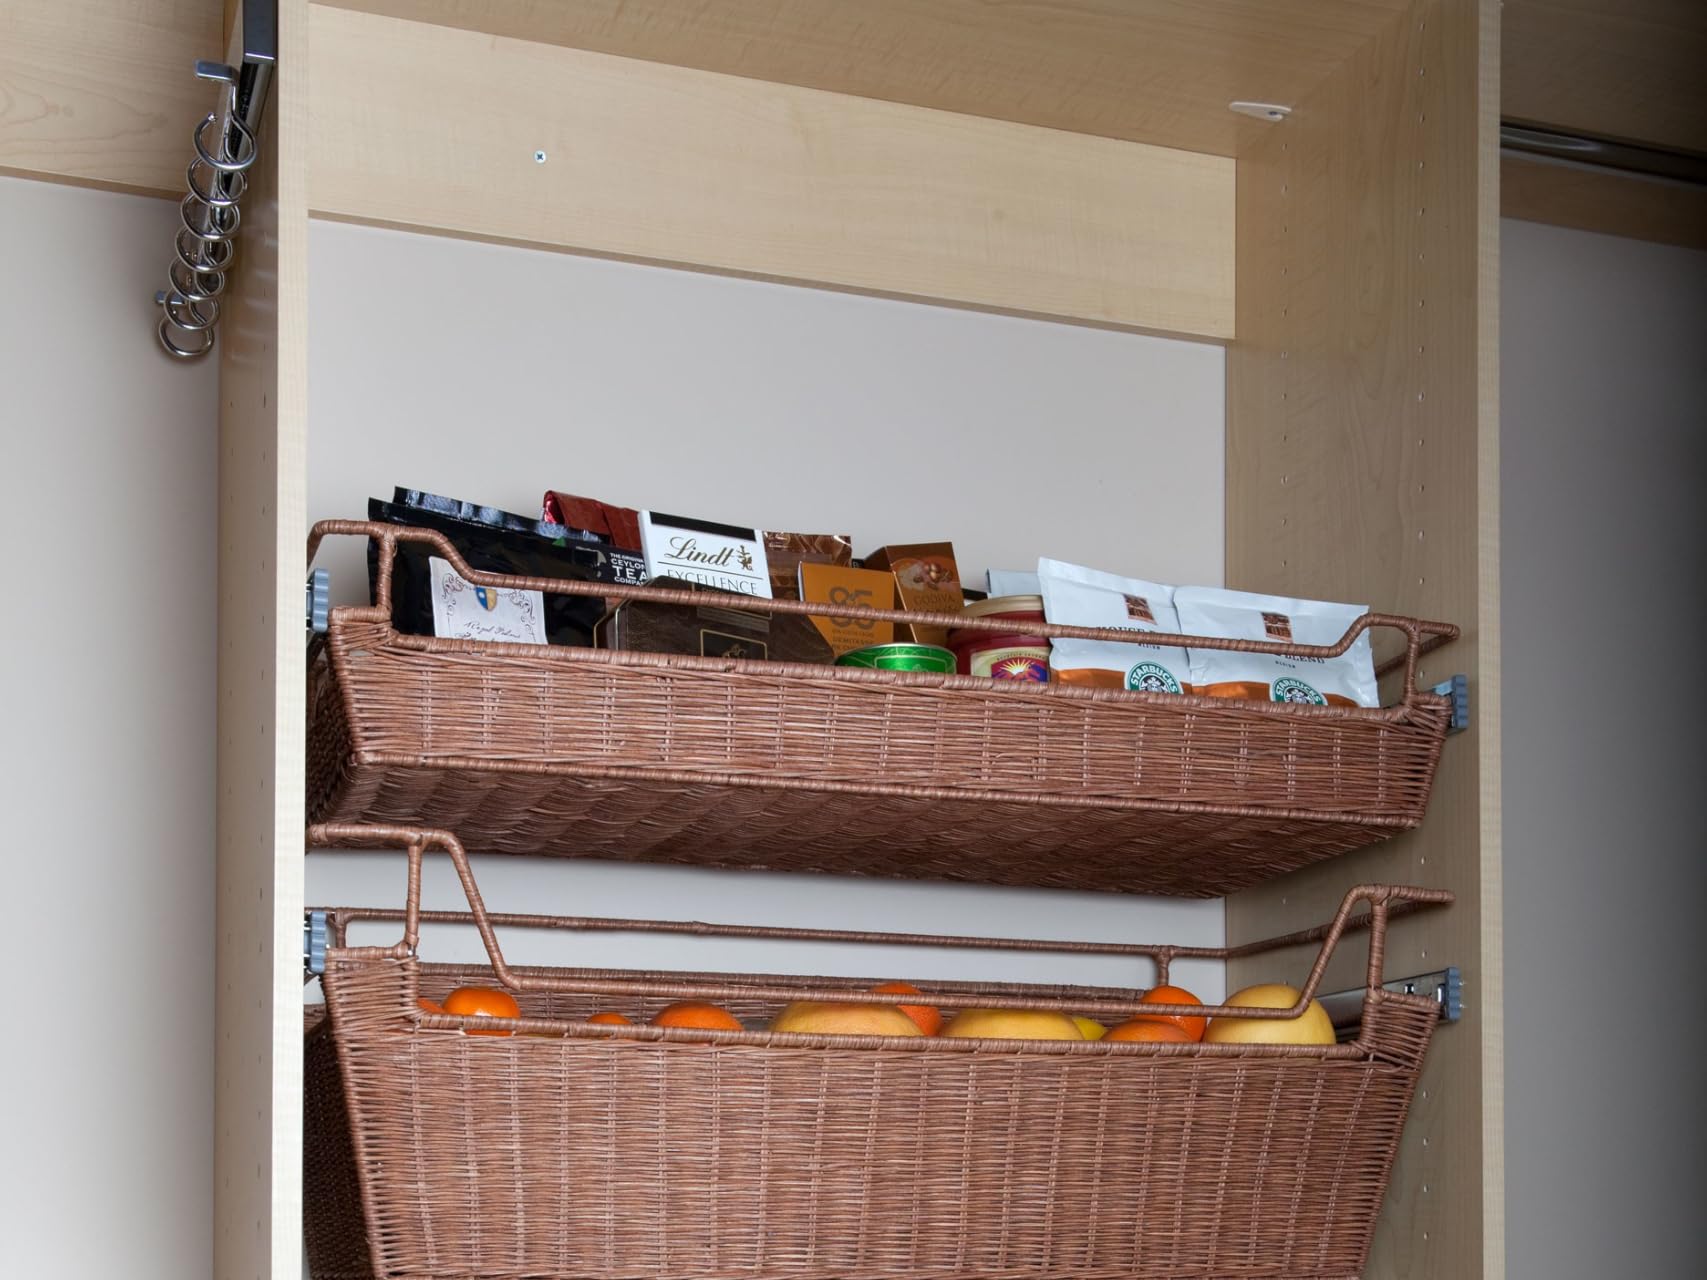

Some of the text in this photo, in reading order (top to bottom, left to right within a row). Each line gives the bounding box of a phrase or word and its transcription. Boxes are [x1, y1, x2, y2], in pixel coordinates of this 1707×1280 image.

[664, 536, 734, 567] Lindt
[612, 564, 647, 581] TEA
[614, 576, 644, 586] COMPA
[829, 586, 876, 630] 85
[1130, 665, 1178, 692] STARBUCKS
[1275, 679, 1321, 702] STARBUCKS
